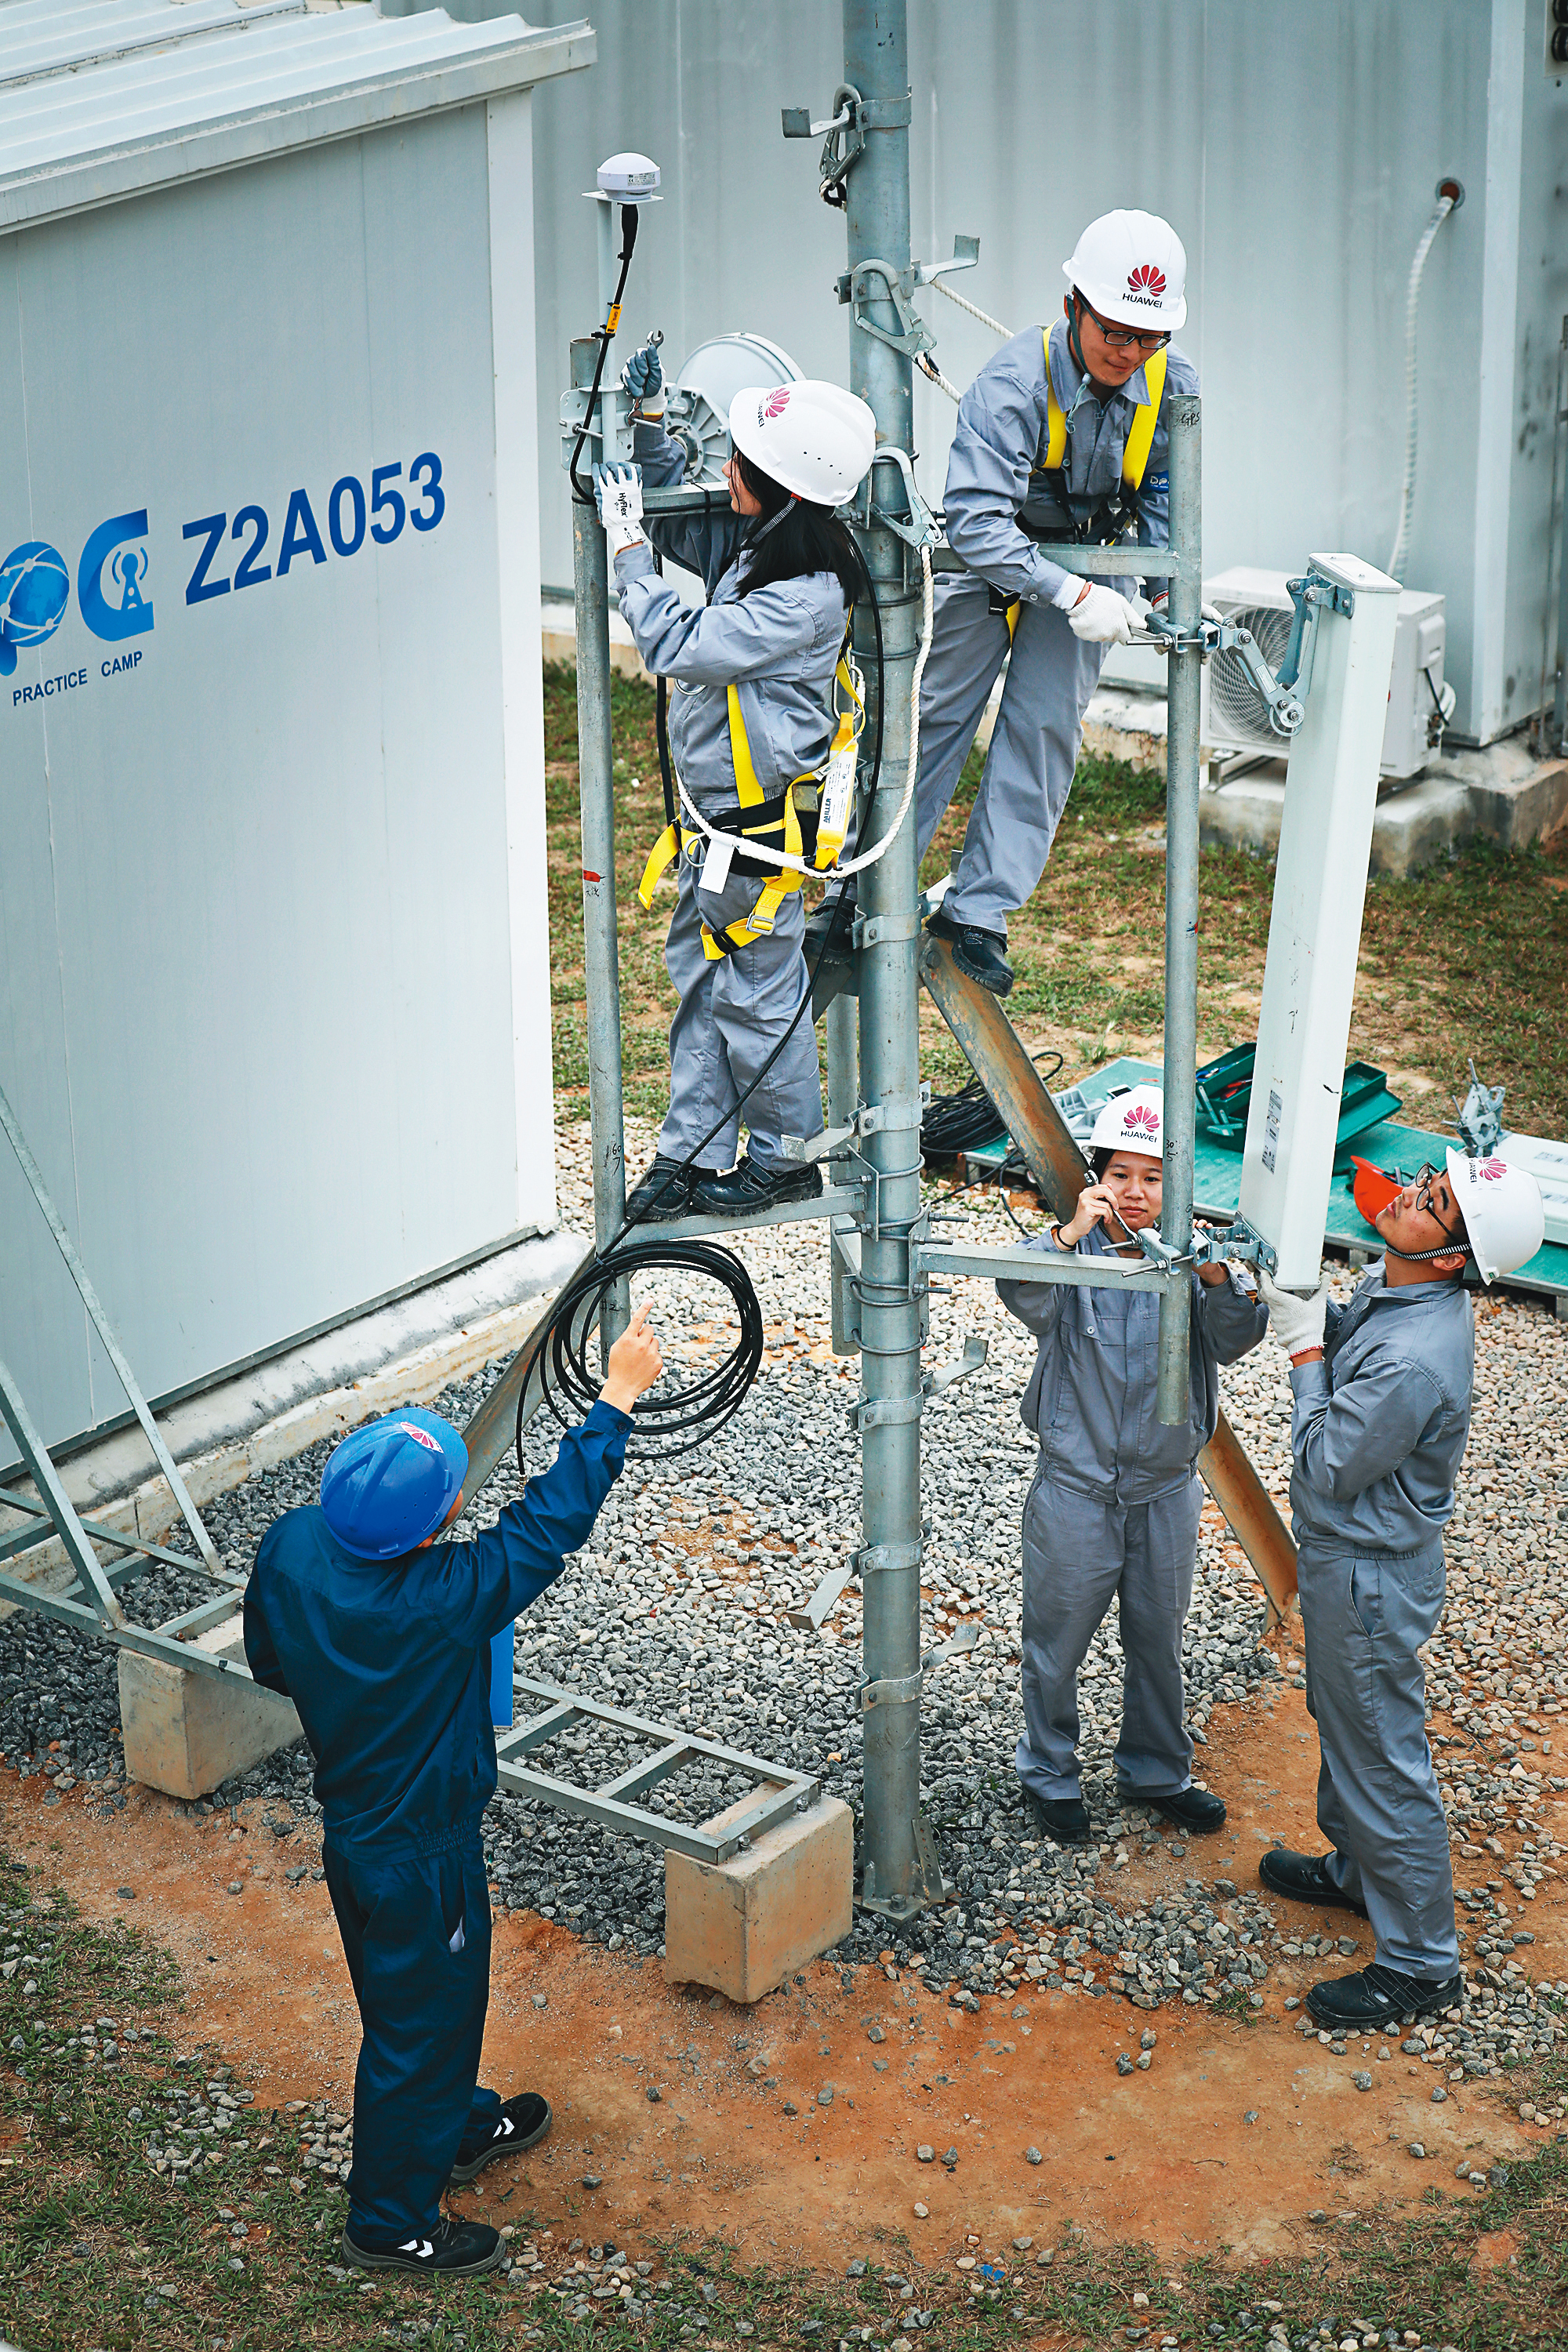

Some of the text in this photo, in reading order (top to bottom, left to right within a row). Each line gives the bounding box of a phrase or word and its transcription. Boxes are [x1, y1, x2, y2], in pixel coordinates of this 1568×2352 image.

[1122, 292, 1163, 308] HUAWEI
[1149, 475, 1170, 485] DP
[618, 492, 628, 517] HyFlex
[182, 452, 445, 606] Z2A053
[13, 651, 143, 706] PRACTICE CAMP
[823, 798, 832, 824] MILLER
[1120, 1131, 1157, 1143] HUAWEI
